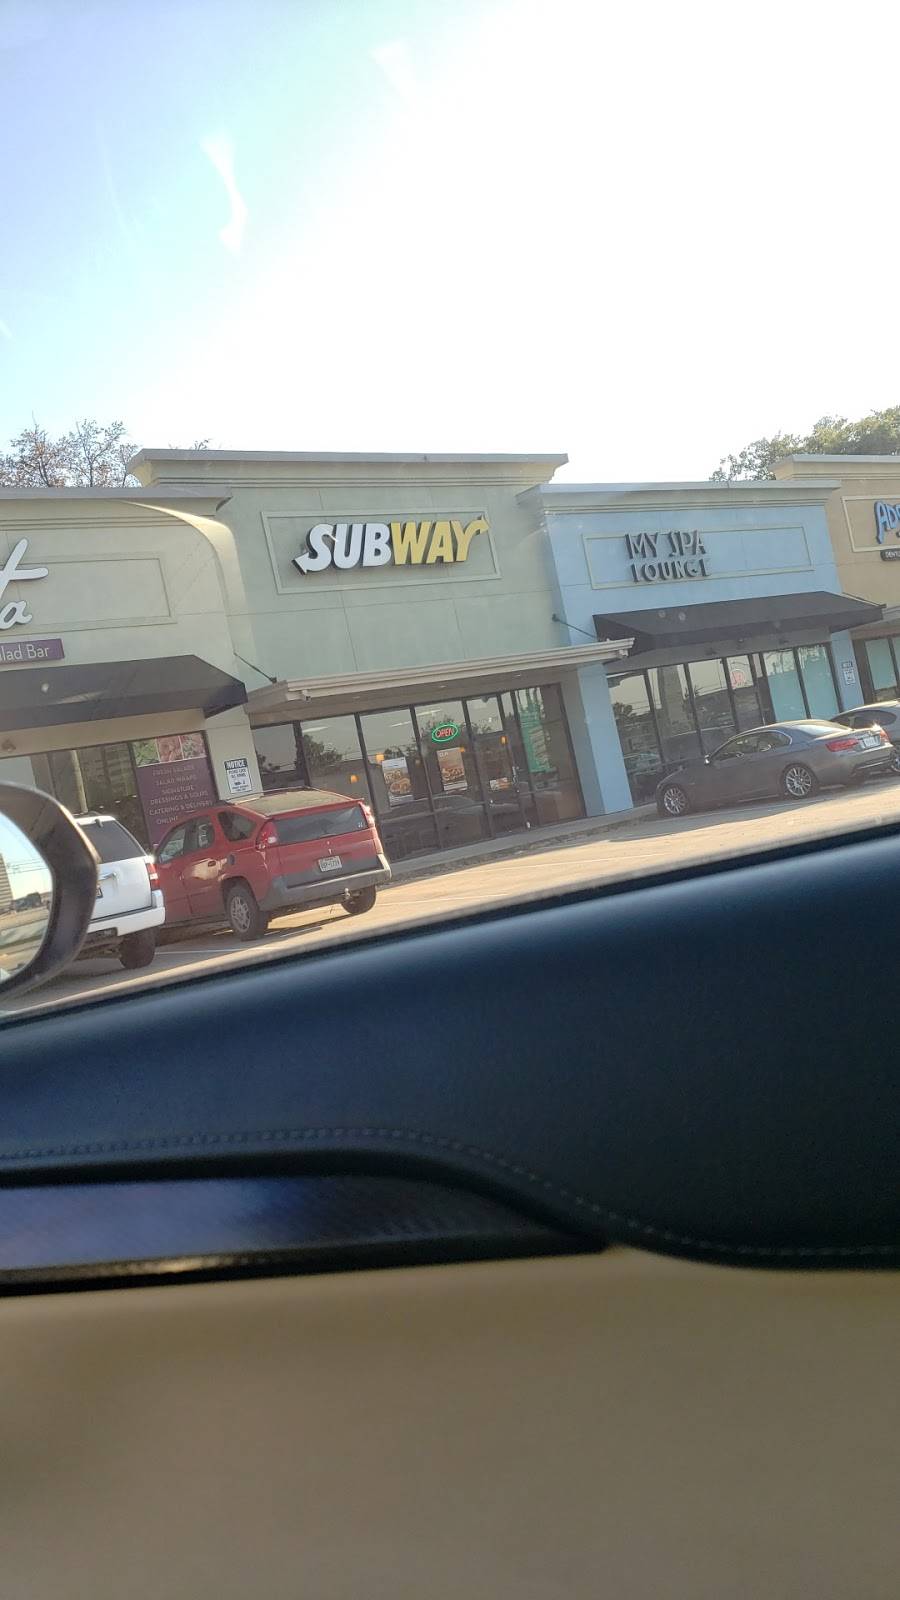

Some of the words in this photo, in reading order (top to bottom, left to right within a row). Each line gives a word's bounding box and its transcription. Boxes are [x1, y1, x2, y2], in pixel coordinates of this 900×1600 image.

[292, 515, 490, 576] SUBWAY
[624, 532, 658, 559] MY
[668, 530, 706, 557] SPA
[630, 559, 711, 582] LOUNGE
[0, 643, 23, 661] lad
[26, 643, 50, 660] Bar
[435, 727, 455, 738] OPEN
[226, 760, 247, 770] NOTICE
[149, 804, 180, 815] CATERING
